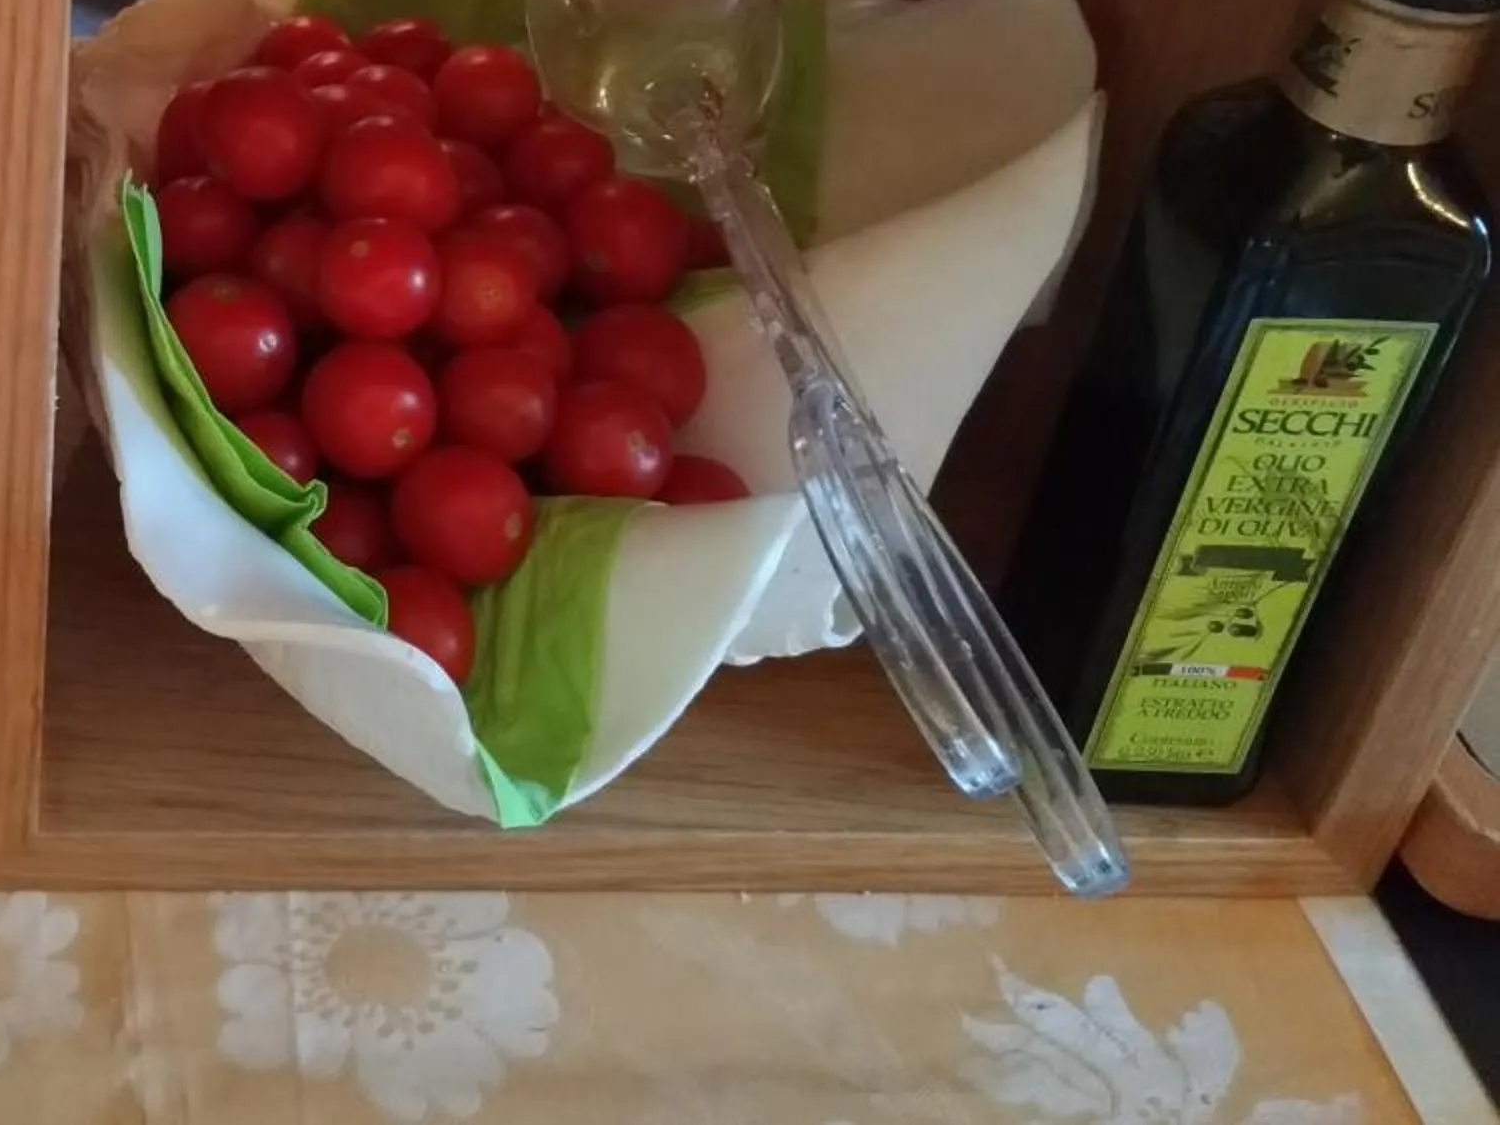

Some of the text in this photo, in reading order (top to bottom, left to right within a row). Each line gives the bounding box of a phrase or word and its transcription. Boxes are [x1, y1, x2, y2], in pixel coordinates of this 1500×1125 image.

[1231, 408, 1380, 438] SECCHI
[1252, 452, 1327, 473] OLIO
[1226, 474, 1329, 495] EXTRA
[1197, 517, 1230, 536] DI
